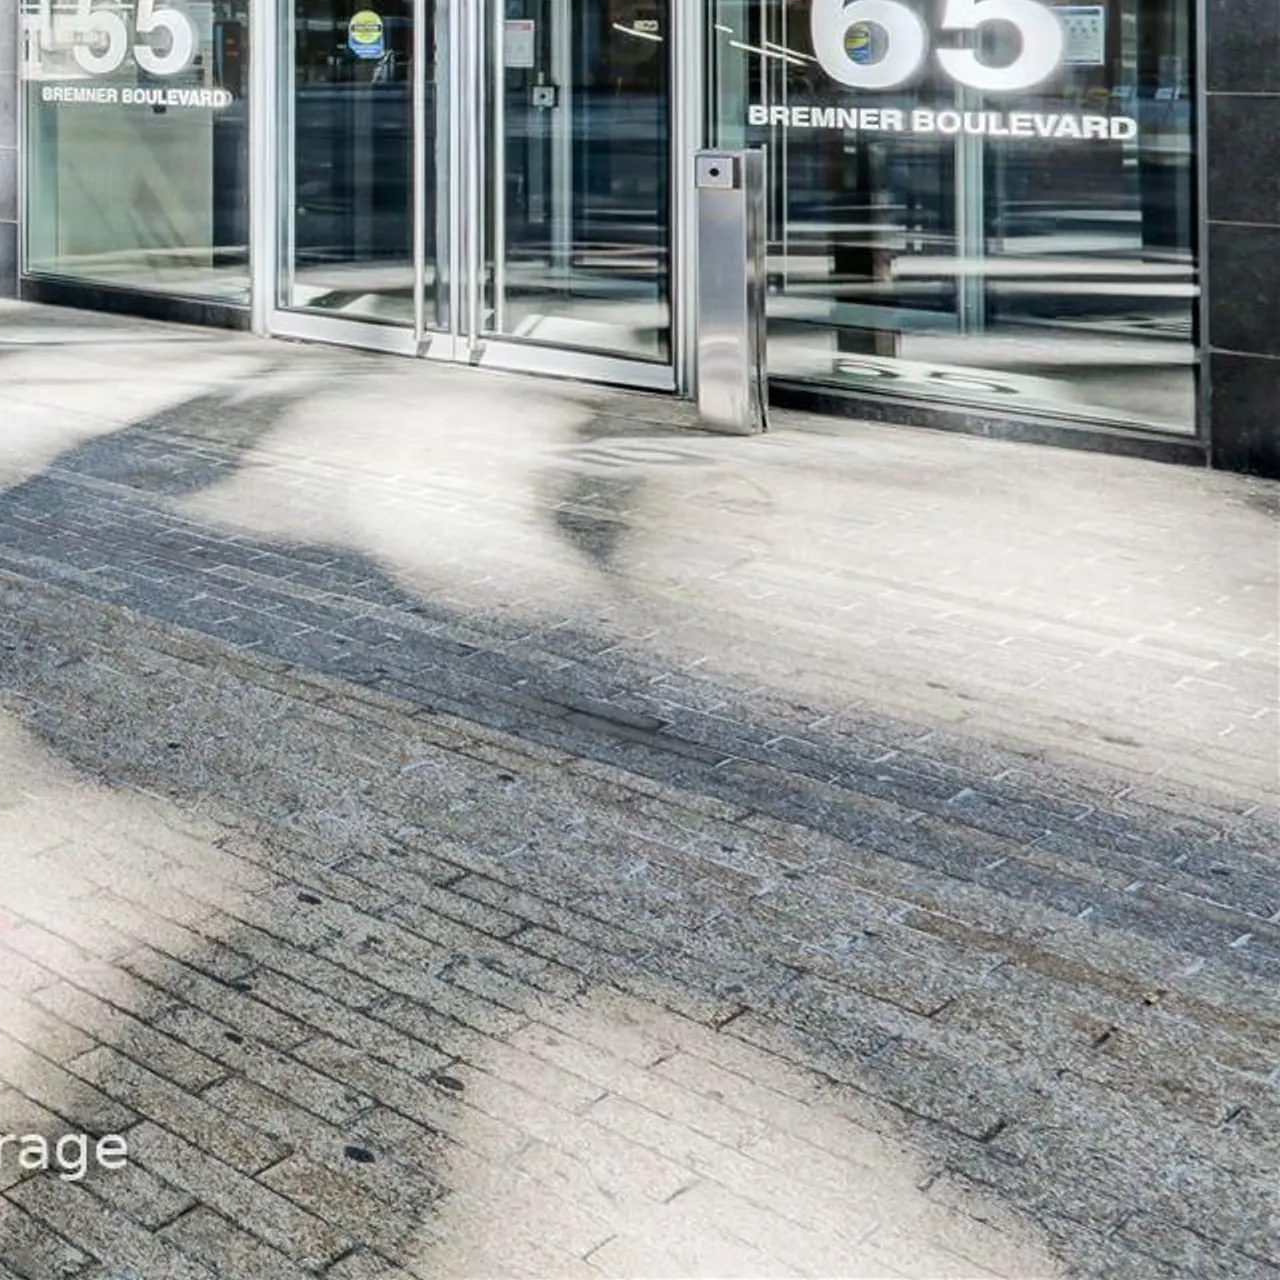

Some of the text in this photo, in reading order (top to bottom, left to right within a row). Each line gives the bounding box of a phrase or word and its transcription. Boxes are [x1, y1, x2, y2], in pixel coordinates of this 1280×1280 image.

[42, 86, 233, 108] BREMNER BOULEVARD
[748, 104, 1139, 141] BREMNER BOULEVARD
